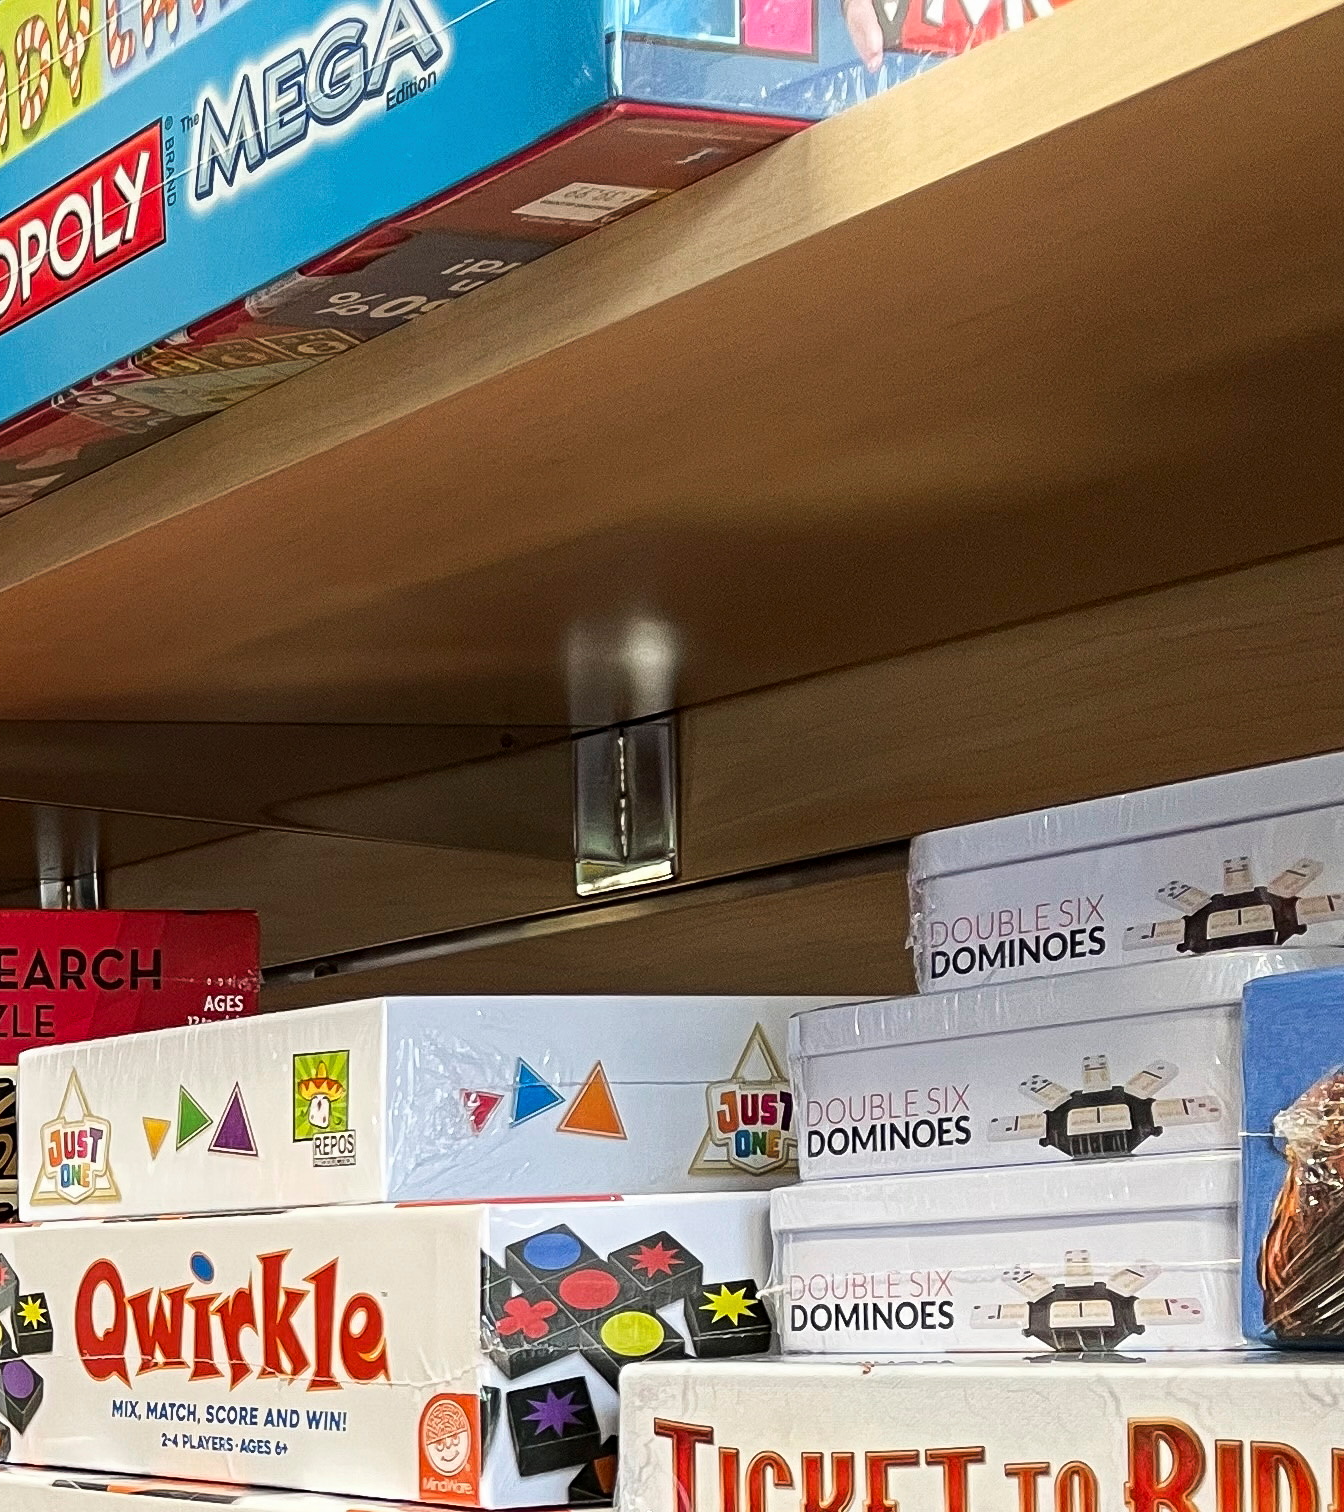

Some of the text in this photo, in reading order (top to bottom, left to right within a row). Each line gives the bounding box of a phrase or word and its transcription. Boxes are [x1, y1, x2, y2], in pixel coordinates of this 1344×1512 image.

[194, 1, 446, 200] MEGA
[385, 68, 438, 112] Edition
[930, 893, 1107, 951] DOUBLE SIX
[930, 925, 1107, 980] DOMINOES
[203, 994, 244, 1012] AGES
[714, 1091, 793, 1134] JUST
[805, 1083, 972, 1127] DOUBLE SIX
[47, 1127, 105, 1168] JUST
[314, 1130, 356, 1158] REPOS
[734, 1125, 783, 1161] ONE
[806, 1114, 973, 1159] DOMINOES
[59, 1158, 93, 1191] ONE
[788, 1269, 955, 1303] DOUBLE SIX
[73, 1247, 392, 1393] Qwirkle
[788, 1299, 955, 1334] DOMINOES
[110, 1400, 349, 1433] MIX, MATCH, SCORE AND WIN!
